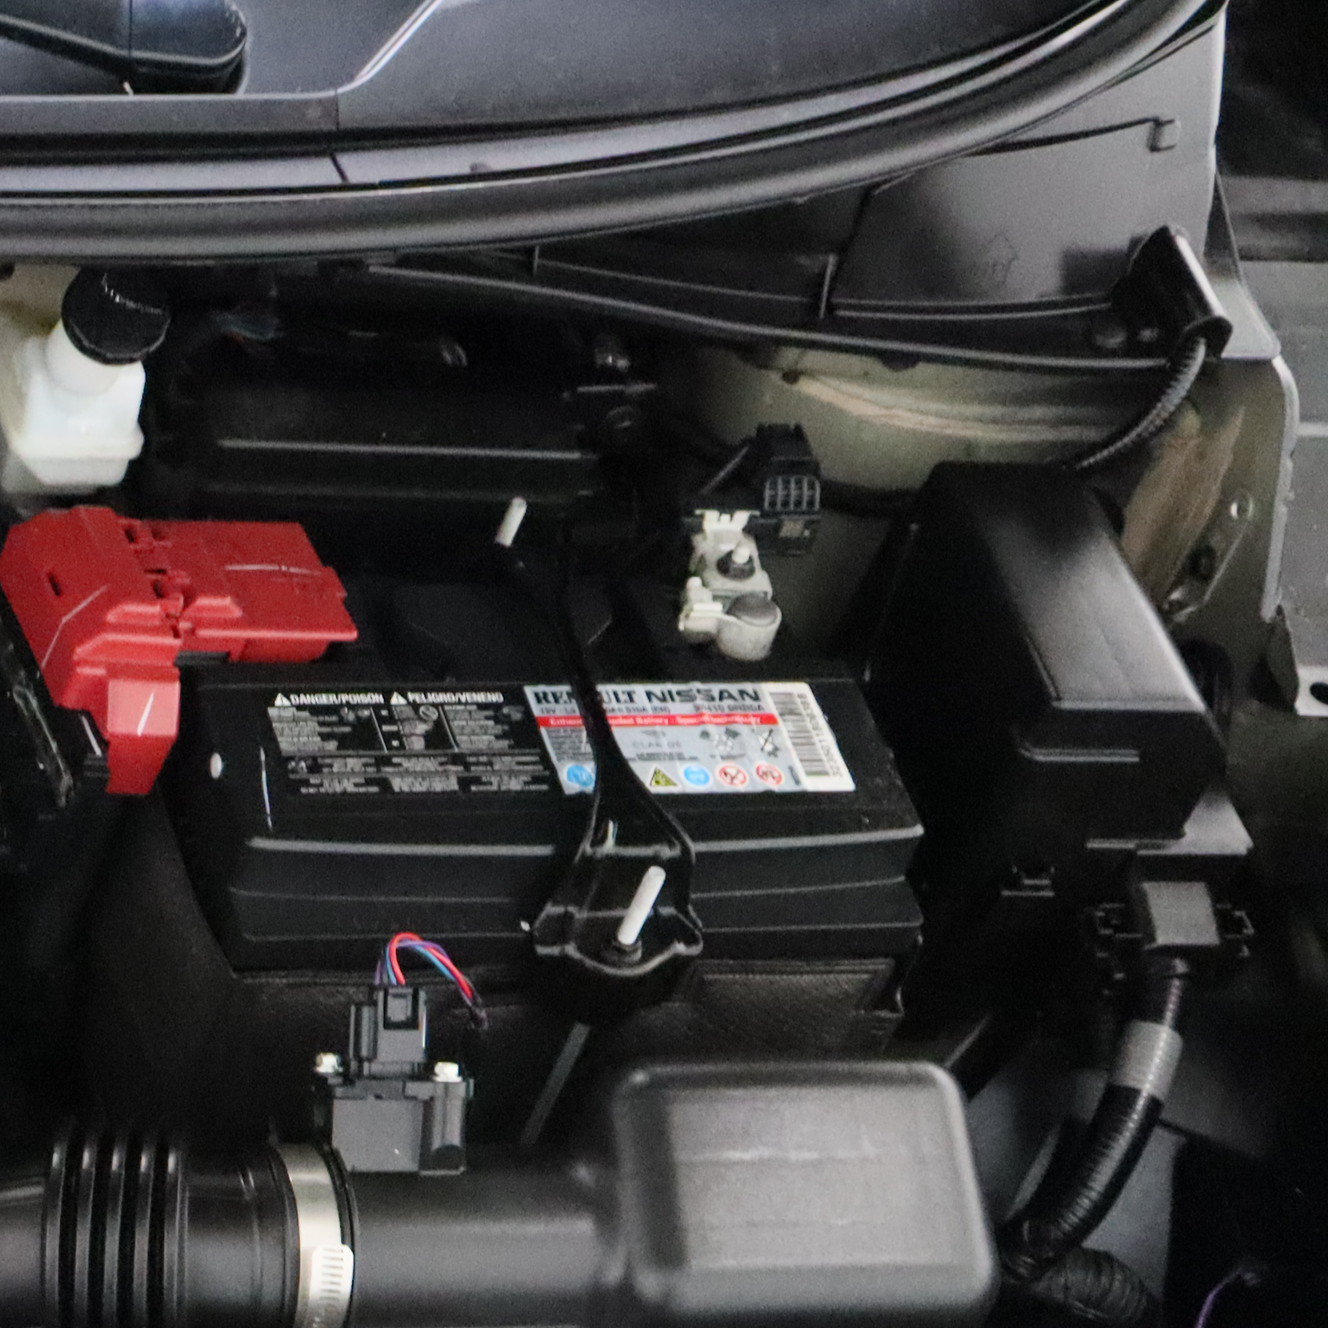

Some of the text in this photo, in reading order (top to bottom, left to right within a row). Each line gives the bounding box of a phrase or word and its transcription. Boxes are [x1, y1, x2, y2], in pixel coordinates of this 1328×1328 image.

[290, 693, 384, 705] DANGER/POISON
[407, 691, 504, 703] PELIGRO/VENENO
[645, 688, 760, 702] NISSAN
